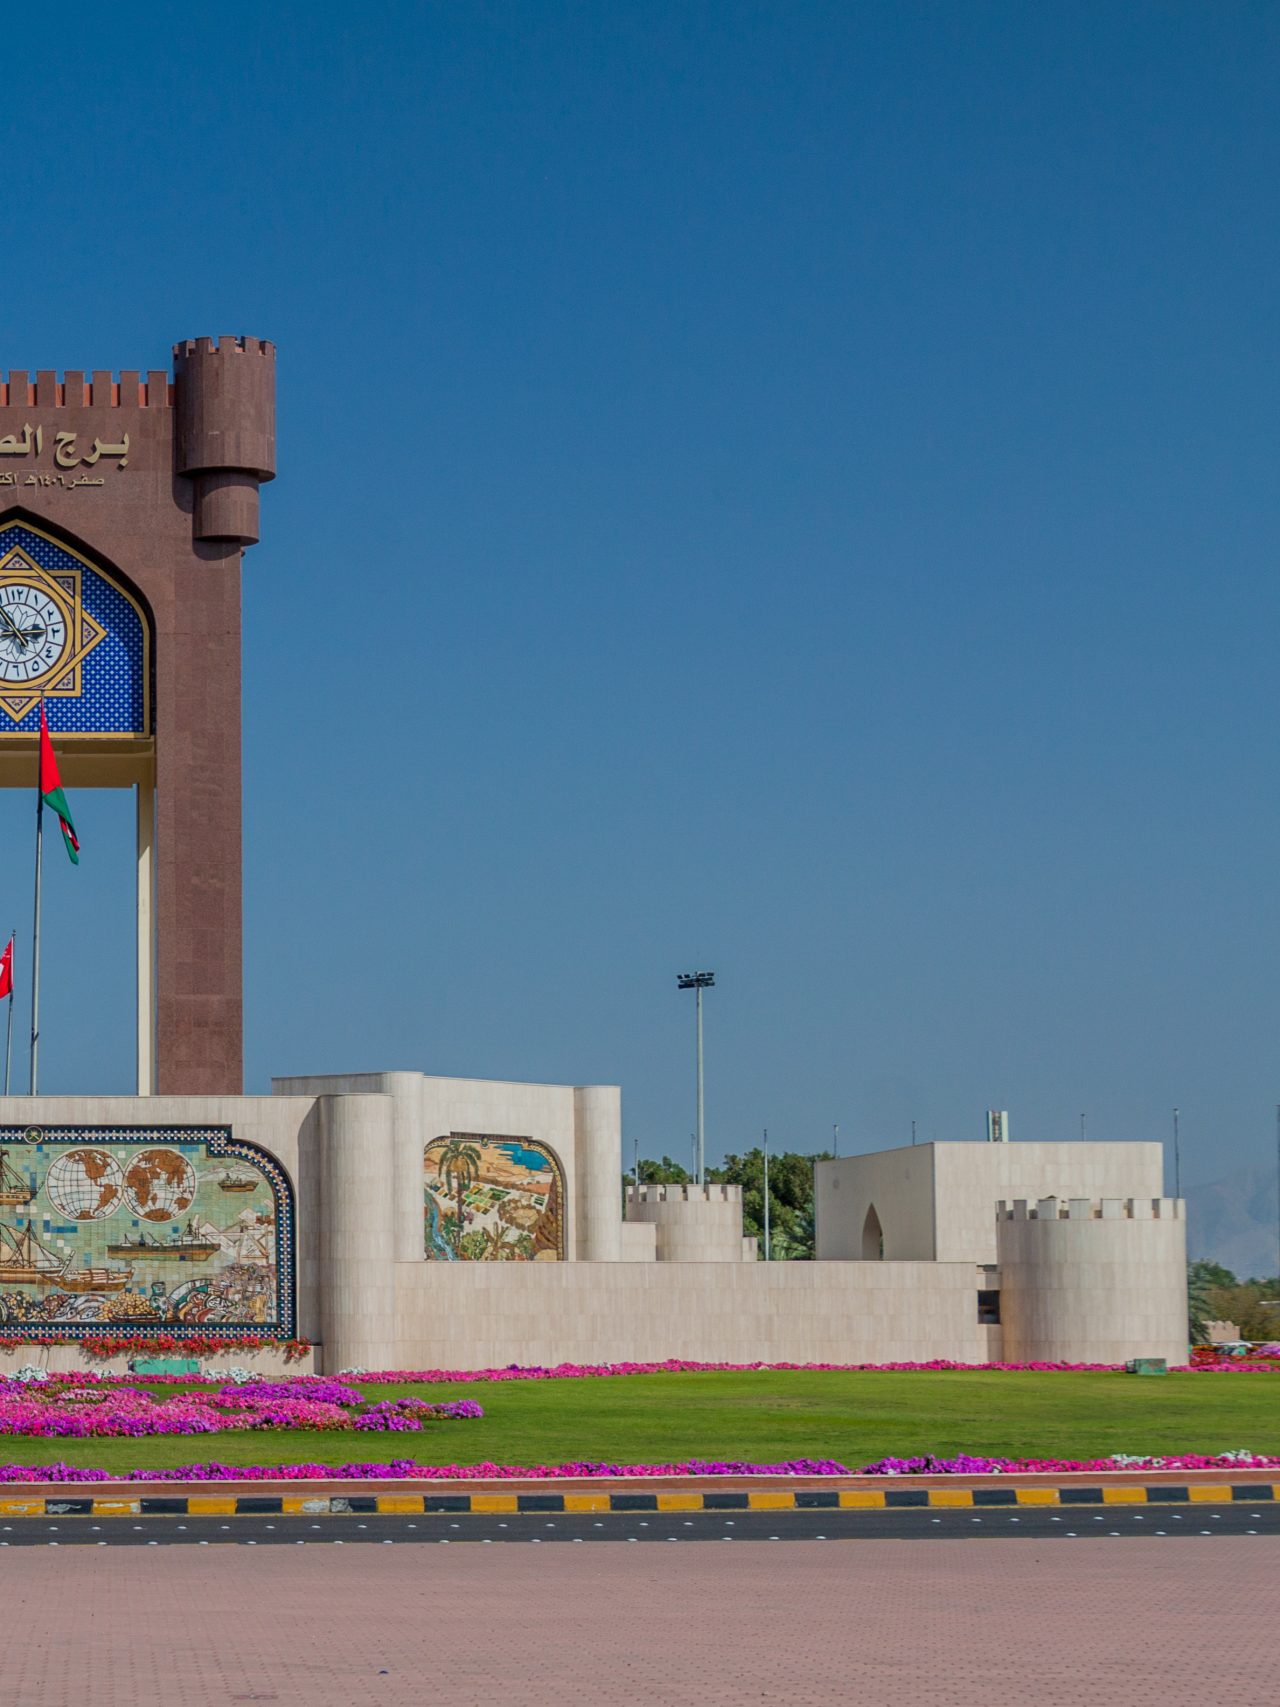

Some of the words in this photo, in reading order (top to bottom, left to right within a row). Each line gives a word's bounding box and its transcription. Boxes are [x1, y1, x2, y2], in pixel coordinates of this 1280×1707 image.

[55, 431, 130, 467] برج
[68, 473, 105, 488] صفر
[11, 589, 24, 601] ١٢
[34, 593, 39, 606] ١
[47, 609, 55, 621] ٢
[45, 645, 54, 659] ٤
[12, 664, 20, 677] ٦
[31, 660, 39, 672] ٥
